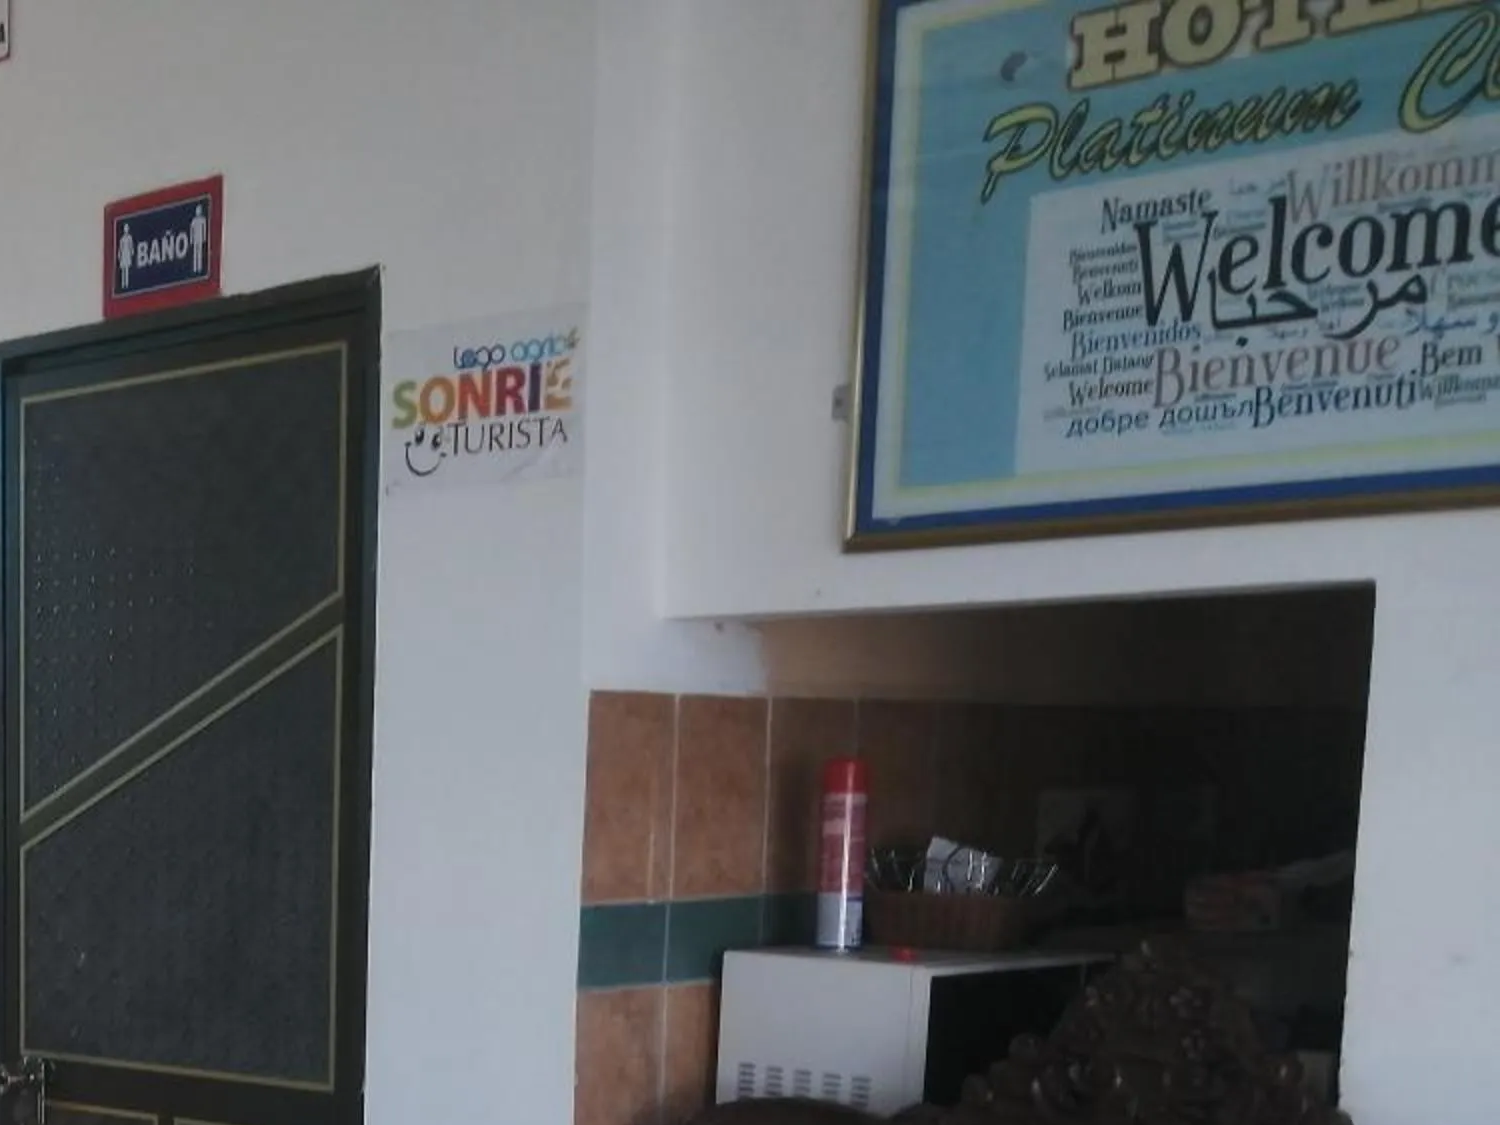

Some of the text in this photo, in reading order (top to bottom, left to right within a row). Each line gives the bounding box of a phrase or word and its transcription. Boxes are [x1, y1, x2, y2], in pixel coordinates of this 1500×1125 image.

[1101, 188, 1212, 235] Namaste
[137, 229, 189, 268] BAÑO
[1071, 316, 1202, 362] Bienvenidos
[1421, 341, 1483, 378] Bem
[1154, 329, 1399, 410] Bienvenue
[1252, 369, 1417, 429] Benvenuti
[449, 418, 568, 456] TURISTA
